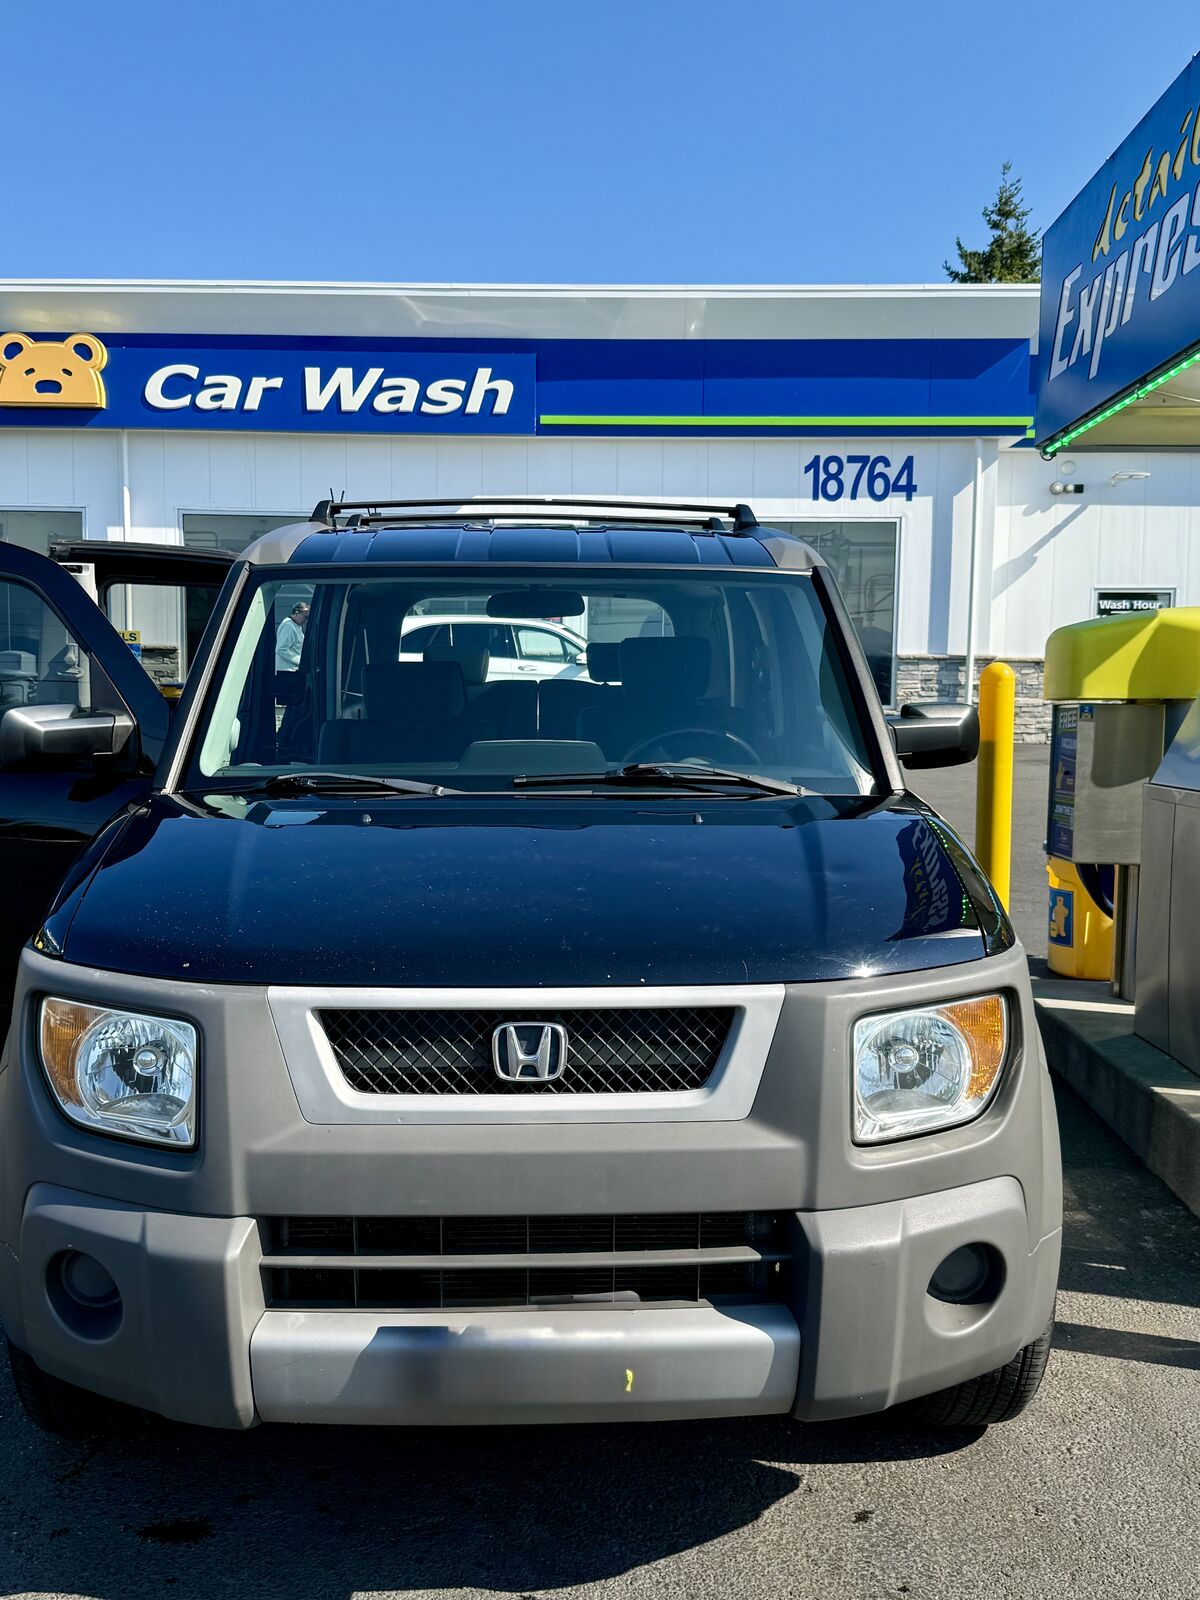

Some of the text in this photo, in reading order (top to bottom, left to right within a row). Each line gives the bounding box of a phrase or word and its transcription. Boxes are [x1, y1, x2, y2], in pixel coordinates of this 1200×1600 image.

[144, 364, 515, 415] Car Wash
[804, 454, 918, 502] 18764
[1100, 600, 1130, 610] Wash
[119, 631, 138, 642] LS
[1059, 709, 1077, 729] FREE
